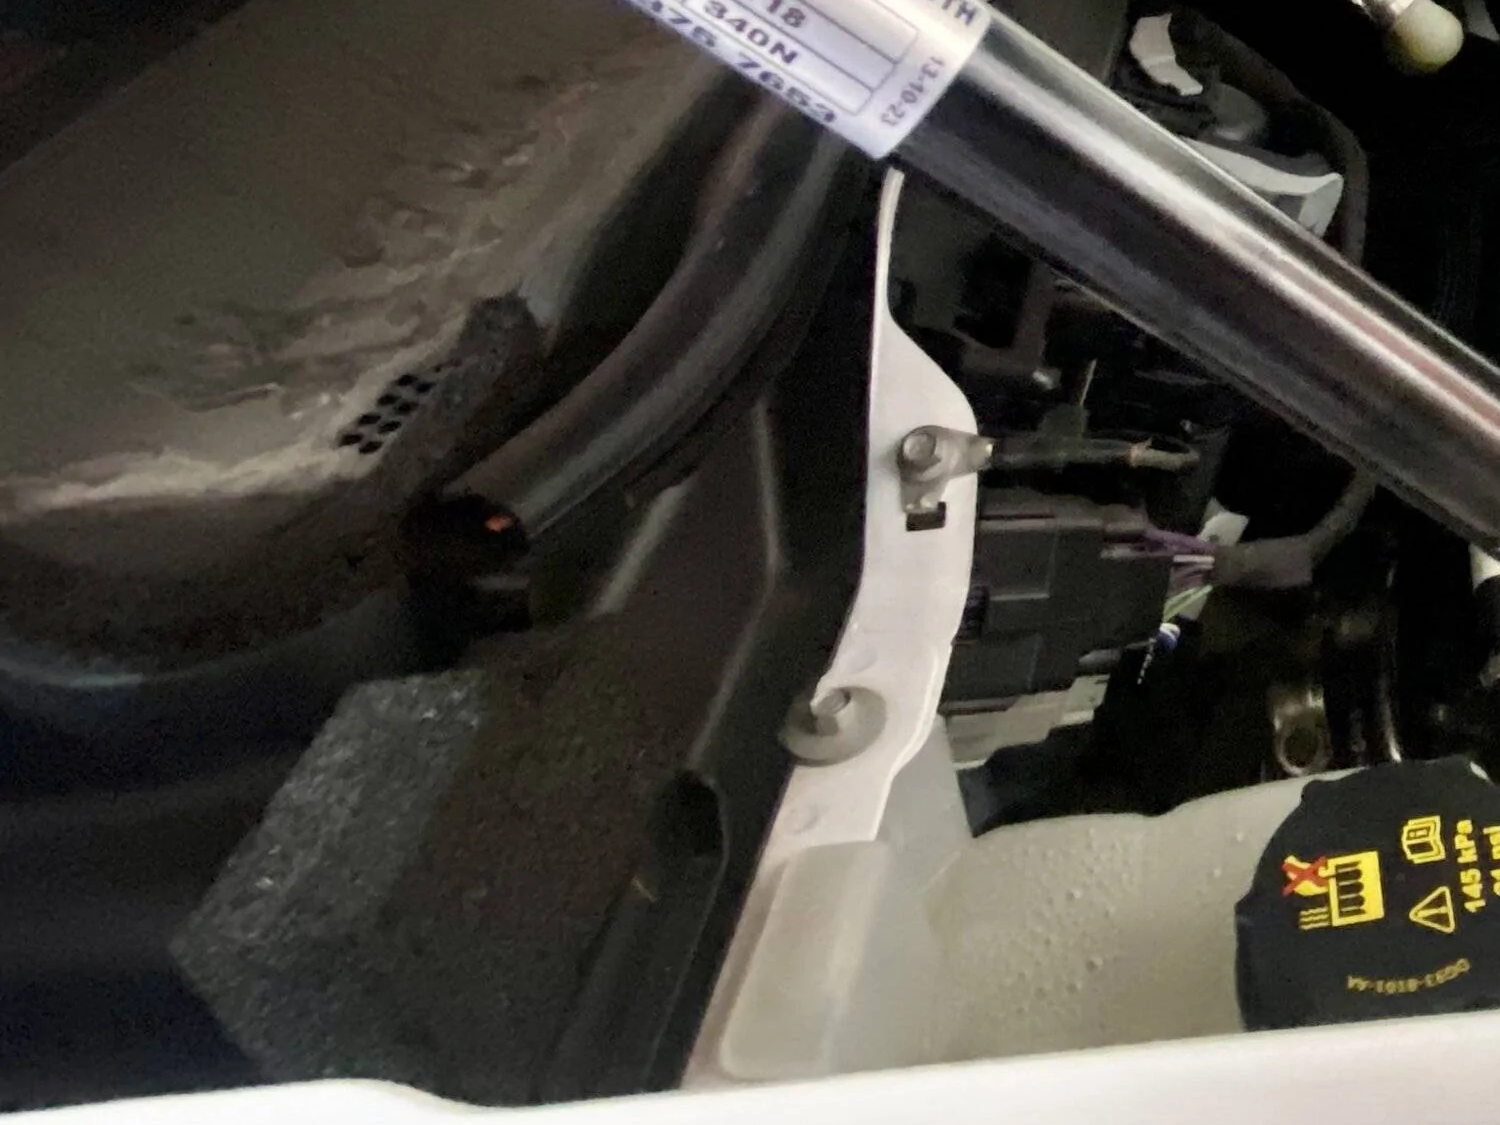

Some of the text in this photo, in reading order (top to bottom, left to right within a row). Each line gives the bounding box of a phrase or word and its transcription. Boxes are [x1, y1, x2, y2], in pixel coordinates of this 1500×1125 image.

[705, 0, 798, 65] 340N
[1455, 819, 1486, 913] 145 kPa
